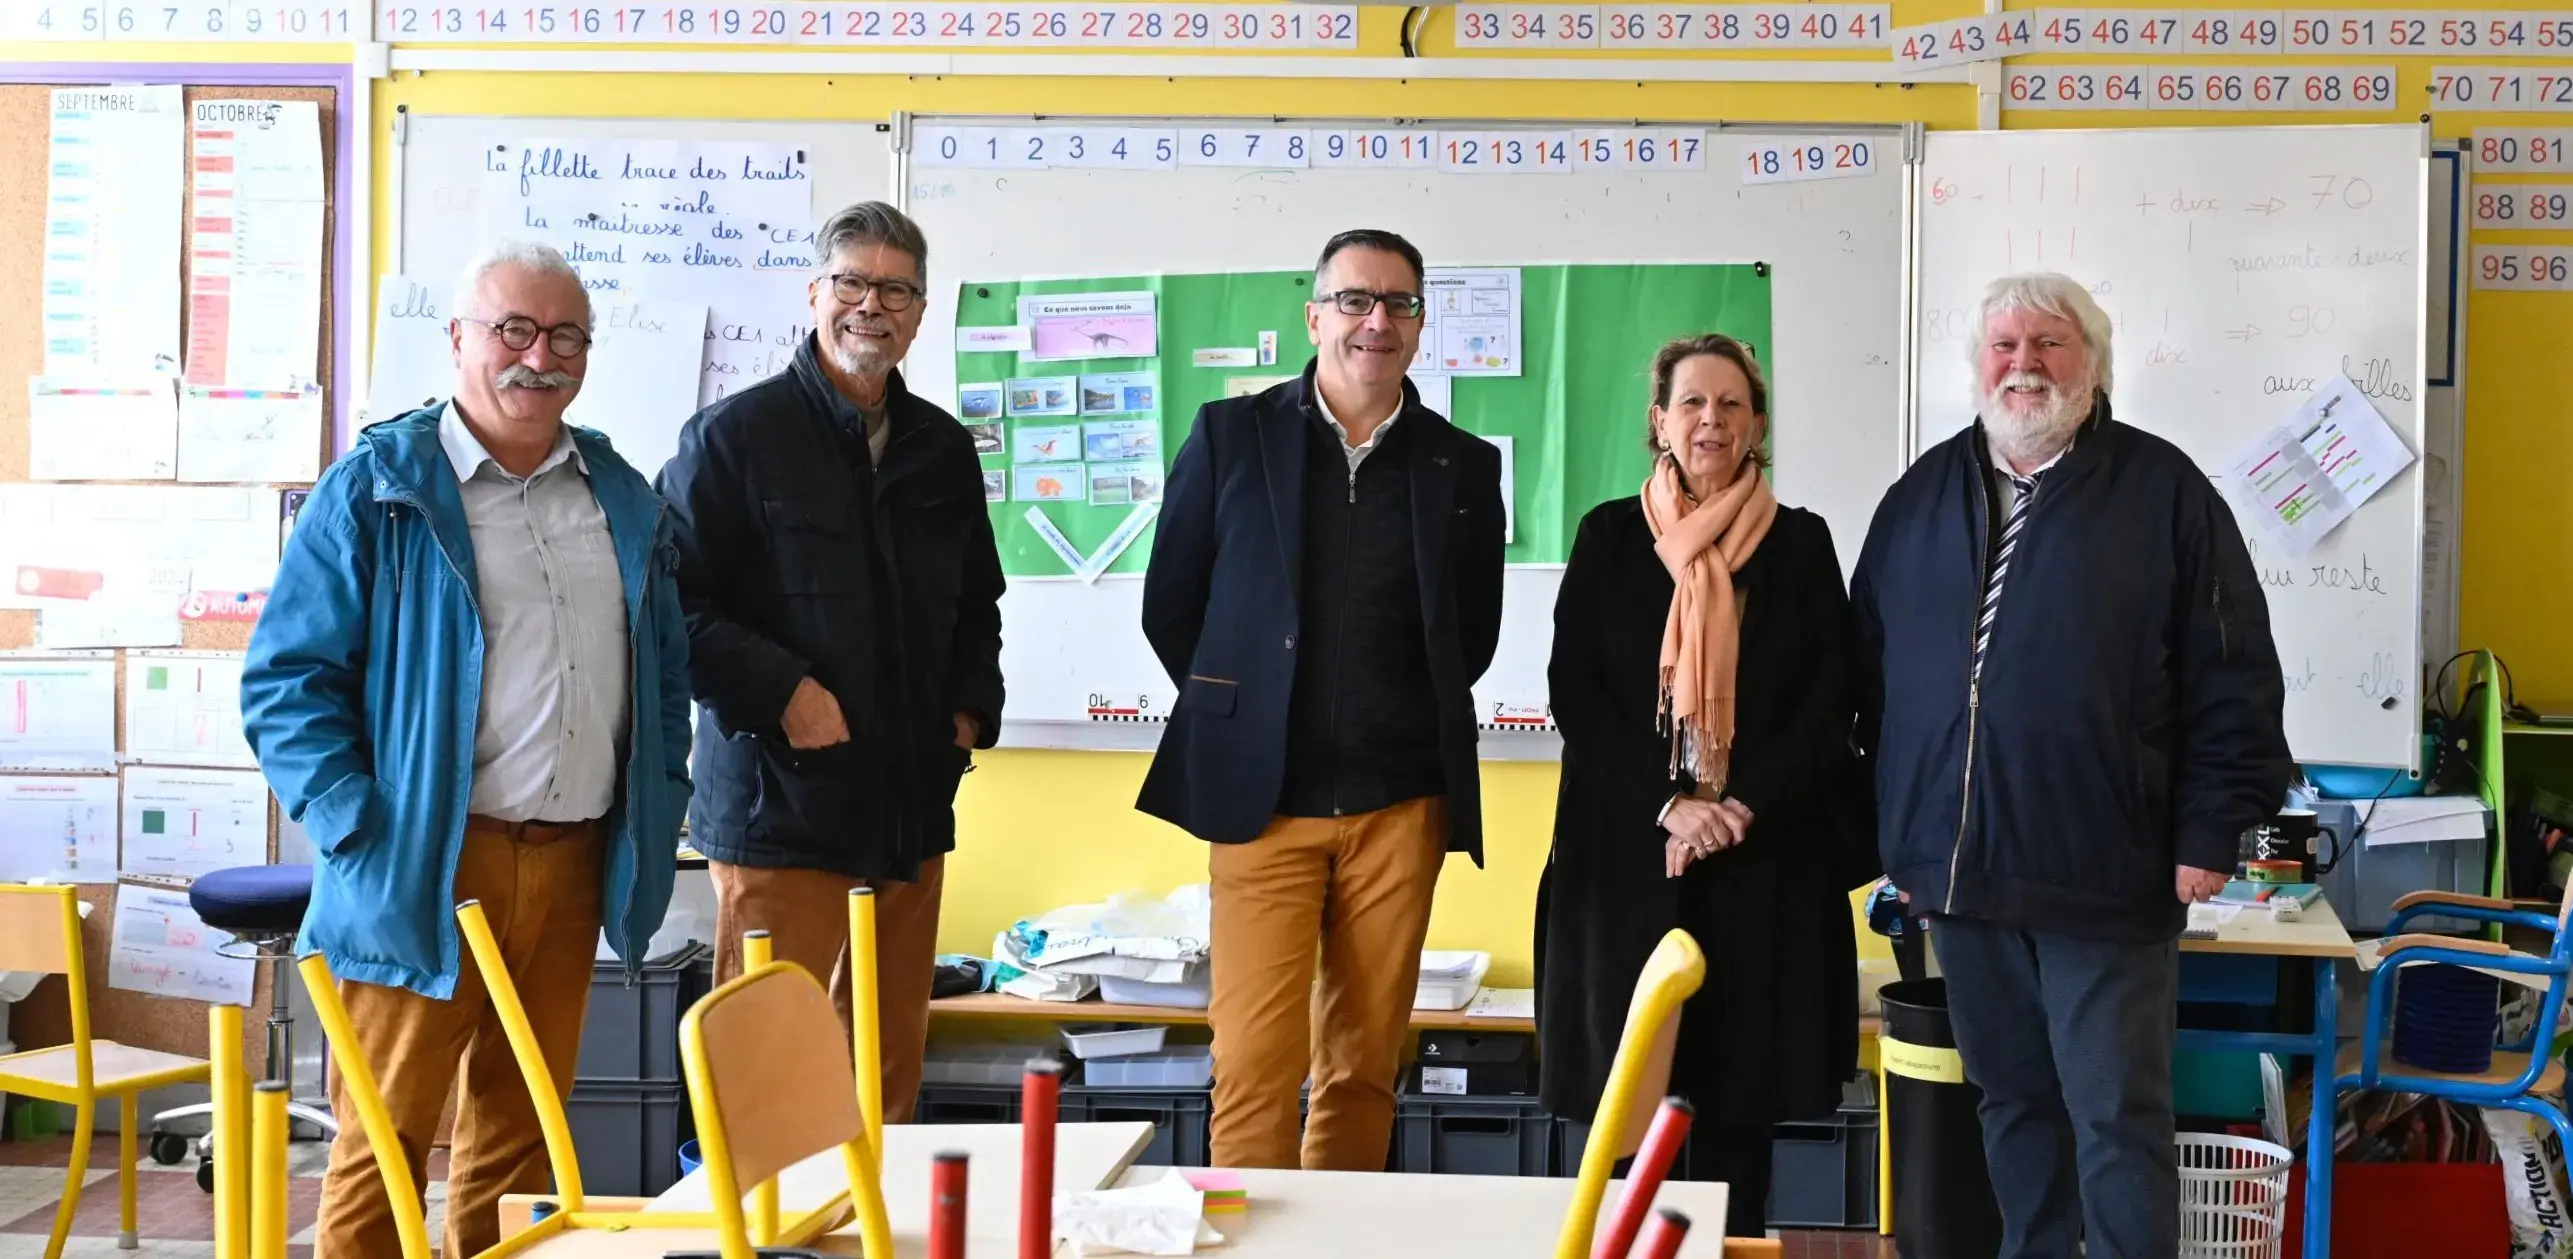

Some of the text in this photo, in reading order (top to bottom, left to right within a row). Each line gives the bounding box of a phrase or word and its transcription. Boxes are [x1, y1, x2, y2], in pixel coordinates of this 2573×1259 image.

[38, 7, 347, 33] 4 5 6 7 8 9 10 11
[387, 8, 1351, 39] 12 13 14 15 16 17 18 19 20 21 22 23 24 25 26 27 28 29 30 31 32
[1465, 13, 1880, 39] 33 34 35 36 37 38 39 40 41
[1902, 18, 2573, 61] 42 43 44 45 46 47 48 49 50 51 52 53 54 55
[2010, 75, 2389, 101] 62 63 64 65 66 67 68 69
[2437, 77, 2573, 102] 70 71 72
[57, 94, 135, 112] SEPTEMBRE
[197, 104, 263, 122] OCTOBRE
[942, 134, 1699, 164] 0 1 2 3 4 5 6 7 8 9 10 11 12 13 14 15 16 17
[1748, 143, 1868, 174] 18 19 20
[2482, 137, 2561, 163] 80 81
[487, 148, 805, 197] La fillette trace des traits
[2308, 175, 2372, 209] 70
[2478, 194, 2566, 220] 88 89
[526, 206, 548, 228] La
[712, 218, 743, 240] des
[771, 229, 814, 246] CE1
[642, 248, 671, 265] ses
[684, 242, 743, 268] élèves
[757, 250, 812, 268] dans
[2482, 255, 2567, 281] 95 96
[391, 283, 438, 319] elle
[723, 325, 762, 344] CE1
[2289, 306, 2336, 338] 90
[2264, 375, 2315, 395] aux
[2309, 552, 2387, 594] reste
[2523, 1152, 2563, 1229] ACTION
